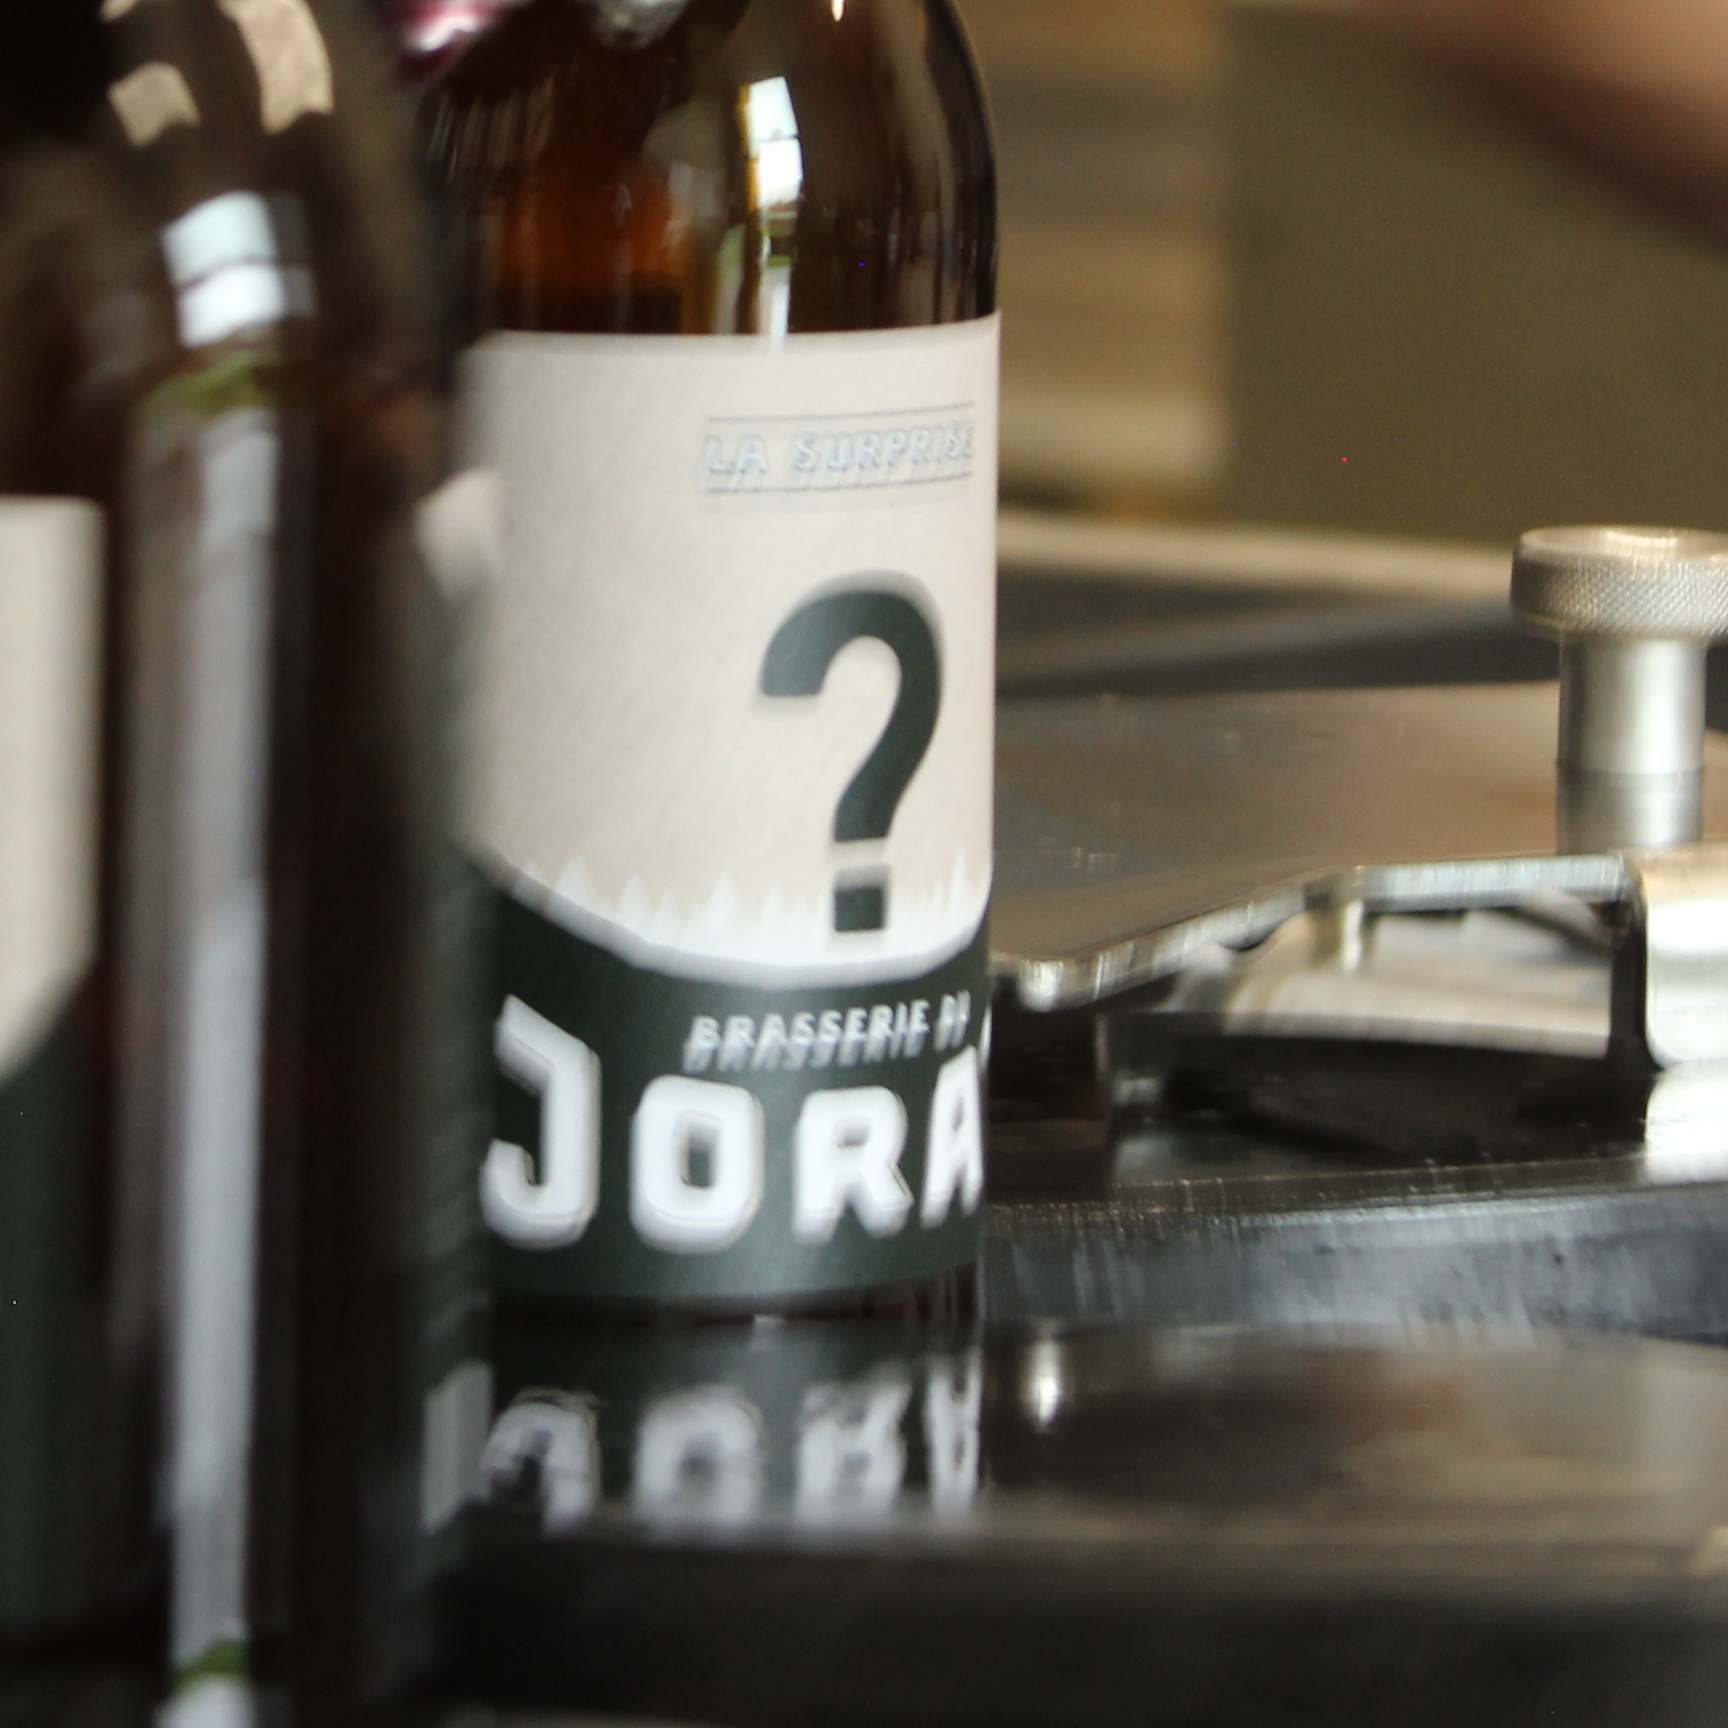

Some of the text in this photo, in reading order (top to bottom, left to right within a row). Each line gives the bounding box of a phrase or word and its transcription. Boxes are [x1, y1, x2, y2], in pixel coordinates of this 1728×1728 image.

[703, 422, 975, 475] LA SURPRISE
[757, 575, 942, 932] ?
[683, 999, 931, 1071] BRASSERIE
[478, 992, 992, 1252] JORA
